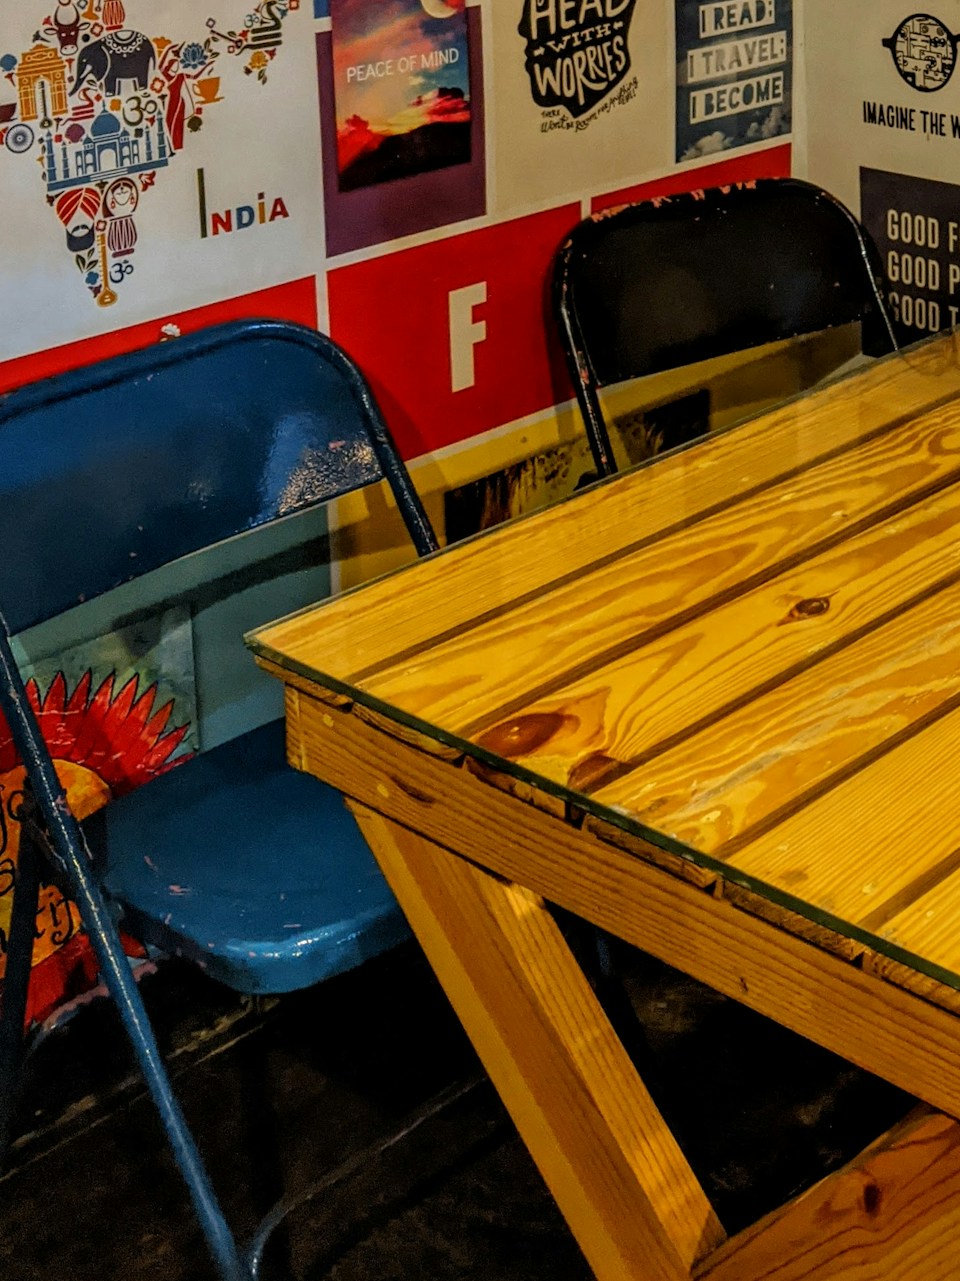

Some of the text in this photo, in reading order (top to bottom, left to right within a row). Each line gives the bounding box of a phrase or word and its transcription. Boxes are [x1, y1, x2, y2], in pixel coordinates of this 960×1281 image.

[546, 23, 611, 53] WITH
[701, 10, 706, 33] I
[346, 47, 460, 84] PEACE OF MIND
[534, 35, 626, 105] WORRIES
[689, 55, 694, 78] I
[691, 77, 782, 119] I BECOME
[863, 101, 916, 131] IMAGINE
[920, 110, 946, 136] THE
[887, 209, 939, 249] GOOD
[888, 251, 940, 291] GOOD
[448, 281, 487, 393] F
